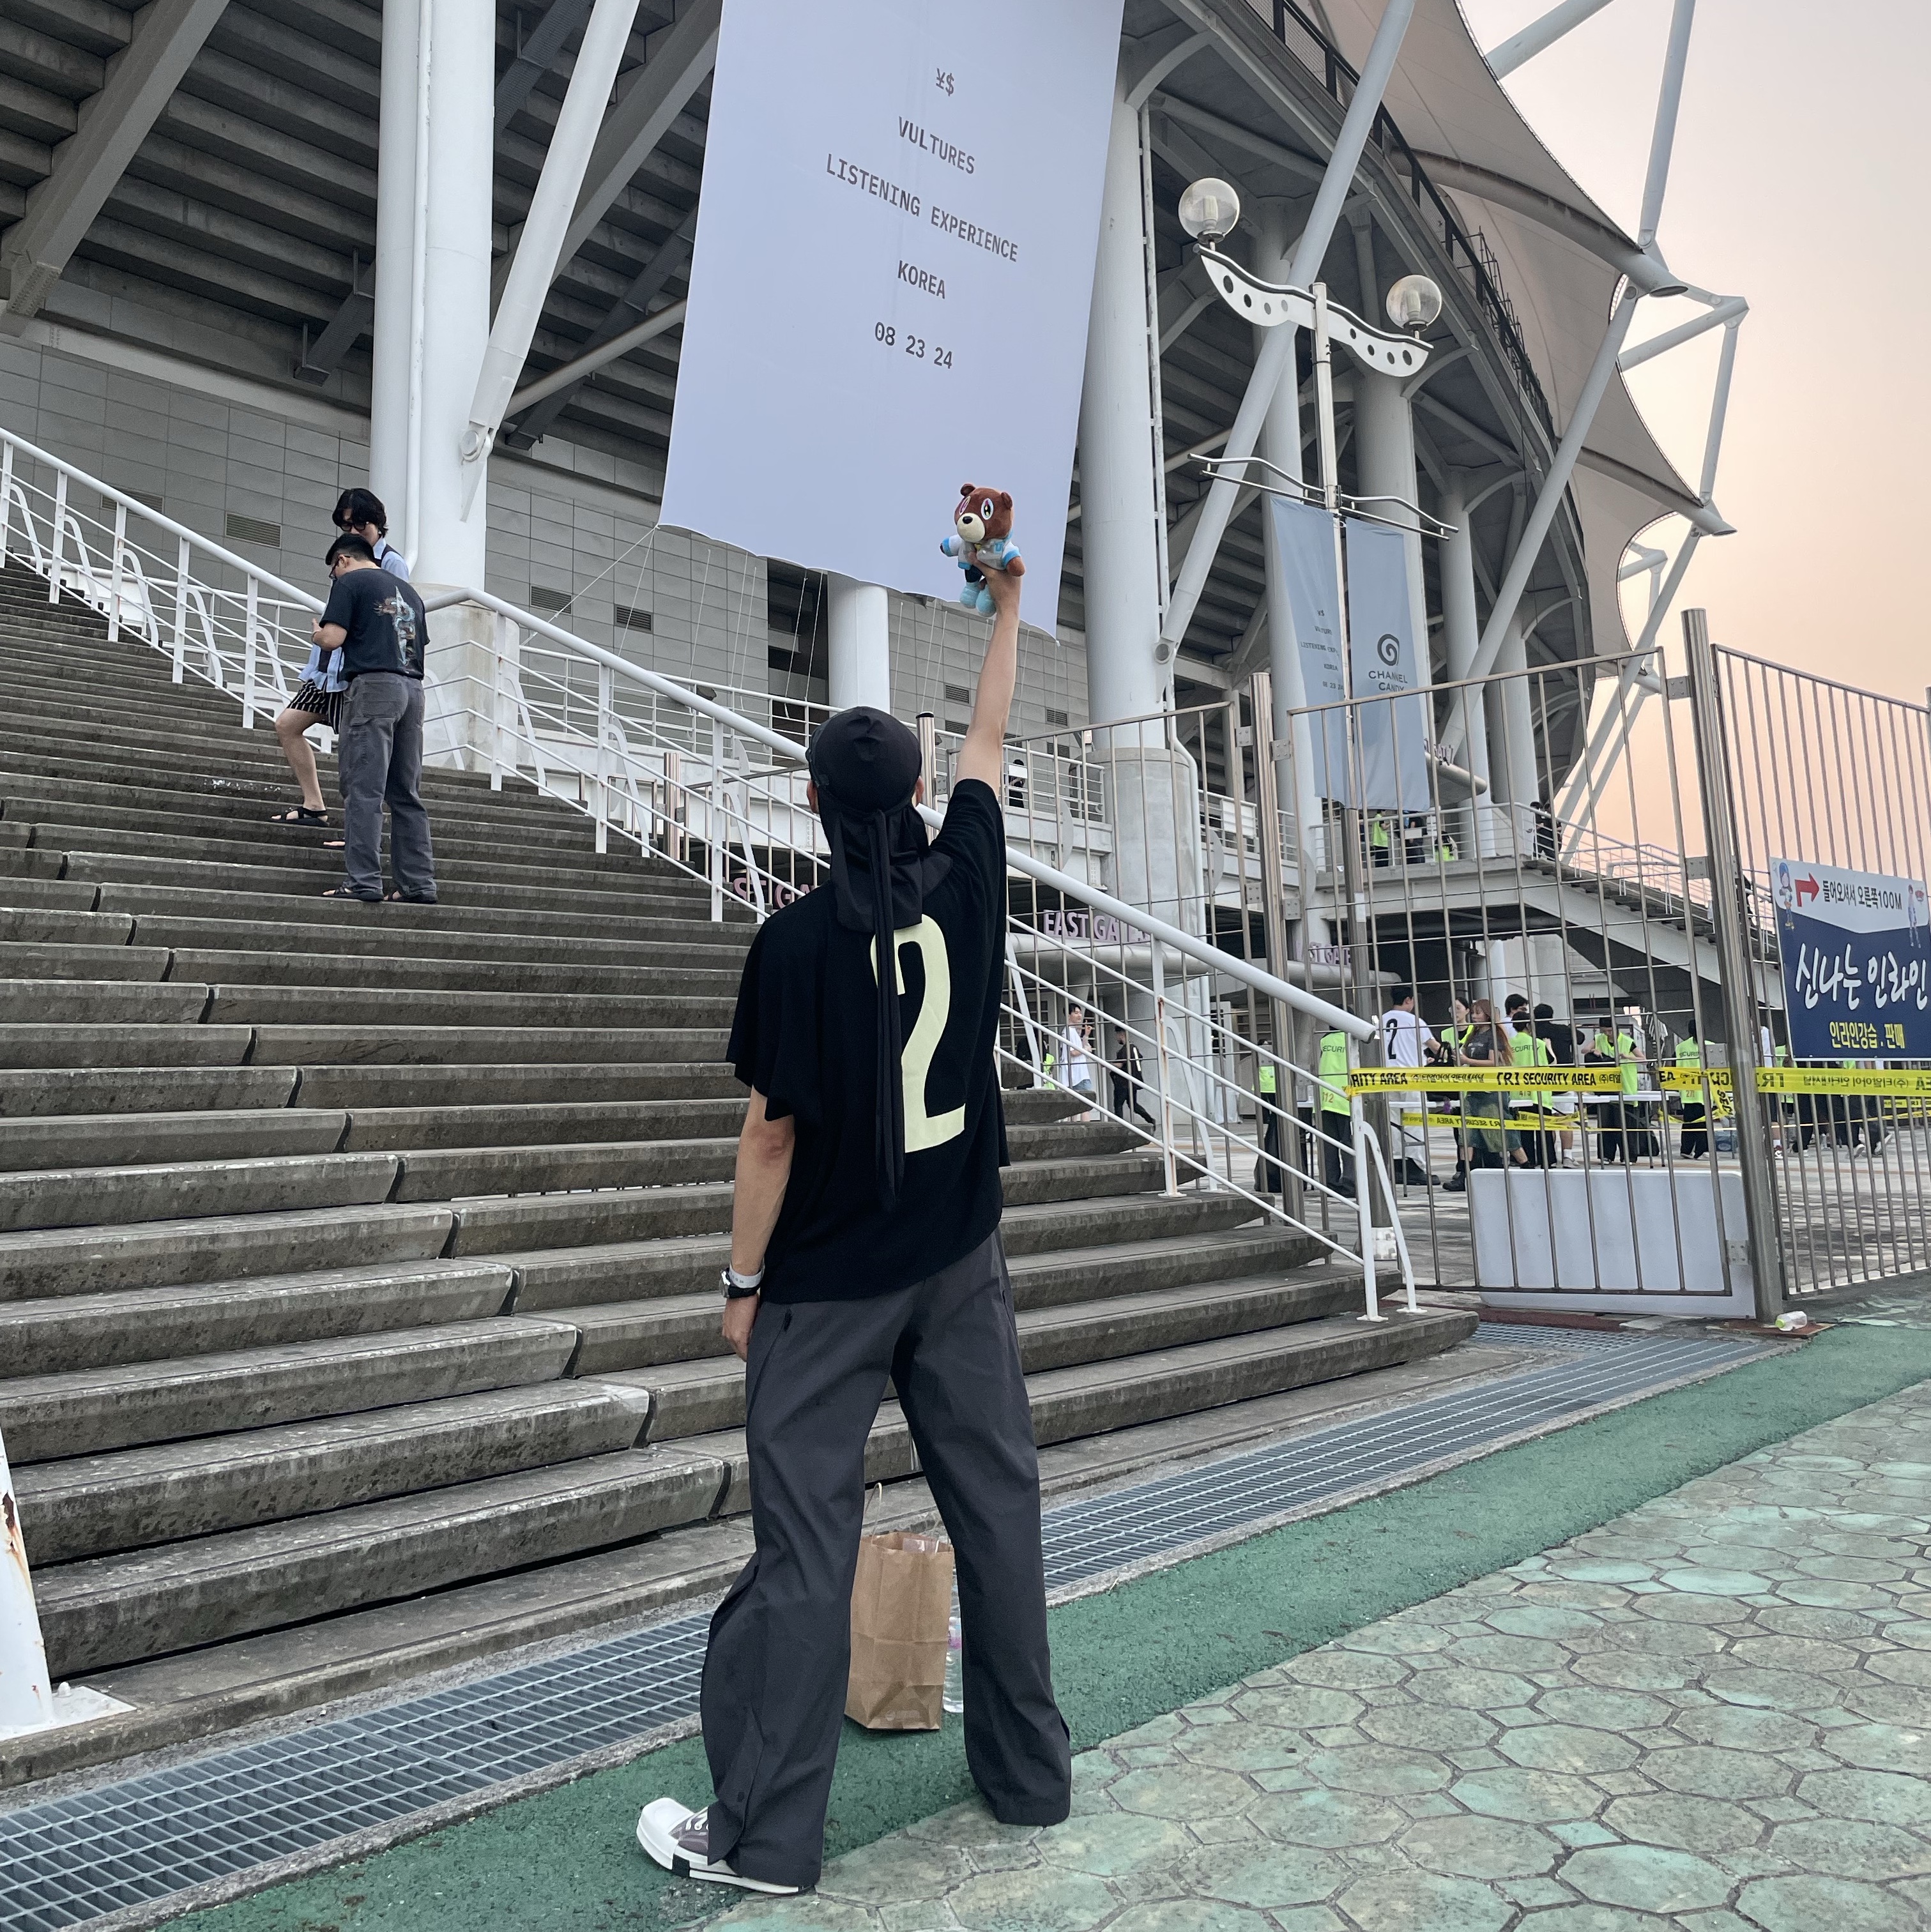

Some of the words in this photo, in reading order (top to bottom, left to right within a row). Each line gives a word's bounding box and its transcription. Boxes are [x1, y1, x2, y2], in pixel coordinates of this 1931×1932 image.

[935, 68, 955, 96] ¥$
[899, 116, 975, 174] VULTURES
[827, 153, 920, 217] LISTENING
[931, 206, 1018, 262] EXPERIENCE
[897, 260, 946, 300] KOREA
[874, 321, 896, 346] 08
[906, 335, 925, 359] 23
[934, 347, 952, 369] 24
[1823, 880, 1856, 906] 들어오셔서
[1044, 909, 1088, 938] EAST
[1795, 943, 1862, 1010] 신나는
[1868, 951, 1927, 1010] 인라인
[871, 913, 965, 1153] 2
[1385, 1018, 1398, 1060] 2
[1884, 1023, 1905, 1049] 판매
[1380, 1073, 1408, 1084] AREA
[1523, 1072, 1569, 1085] SECURITY
[1571, 1073, 1596, 1086] AREA
